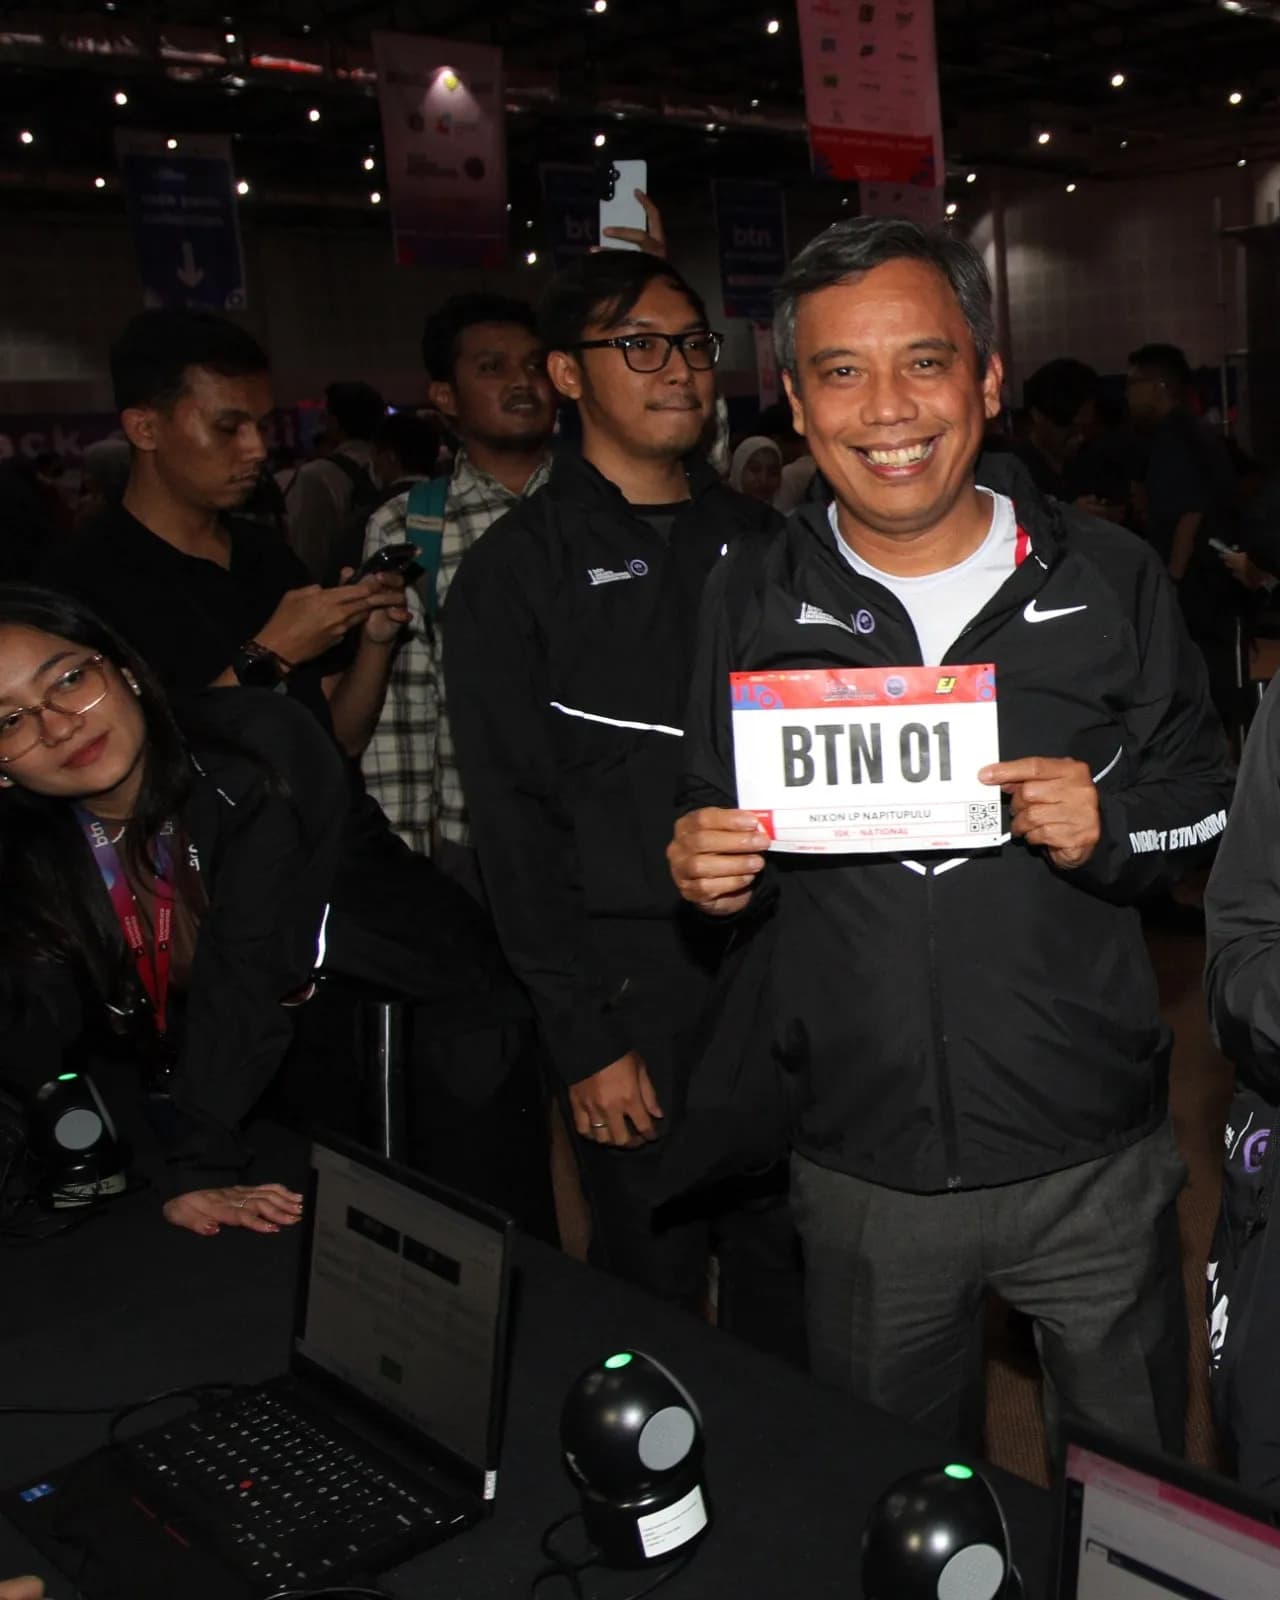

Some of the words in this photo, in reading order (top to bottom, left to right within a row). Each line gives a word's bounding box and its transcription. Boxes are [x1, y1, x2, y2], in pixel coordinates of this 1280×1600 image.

[782, 723, 883, 787] BTN
[900, 722, 952, 783] 01
[809, 811, 846, 822] NIXON
[848, 811, 860, 821] LP
[863, 808, 932, 820] NAPITUPULU
[90, 821, 109, 848] btn
[859, 827, 909, 837] NATIONAL
